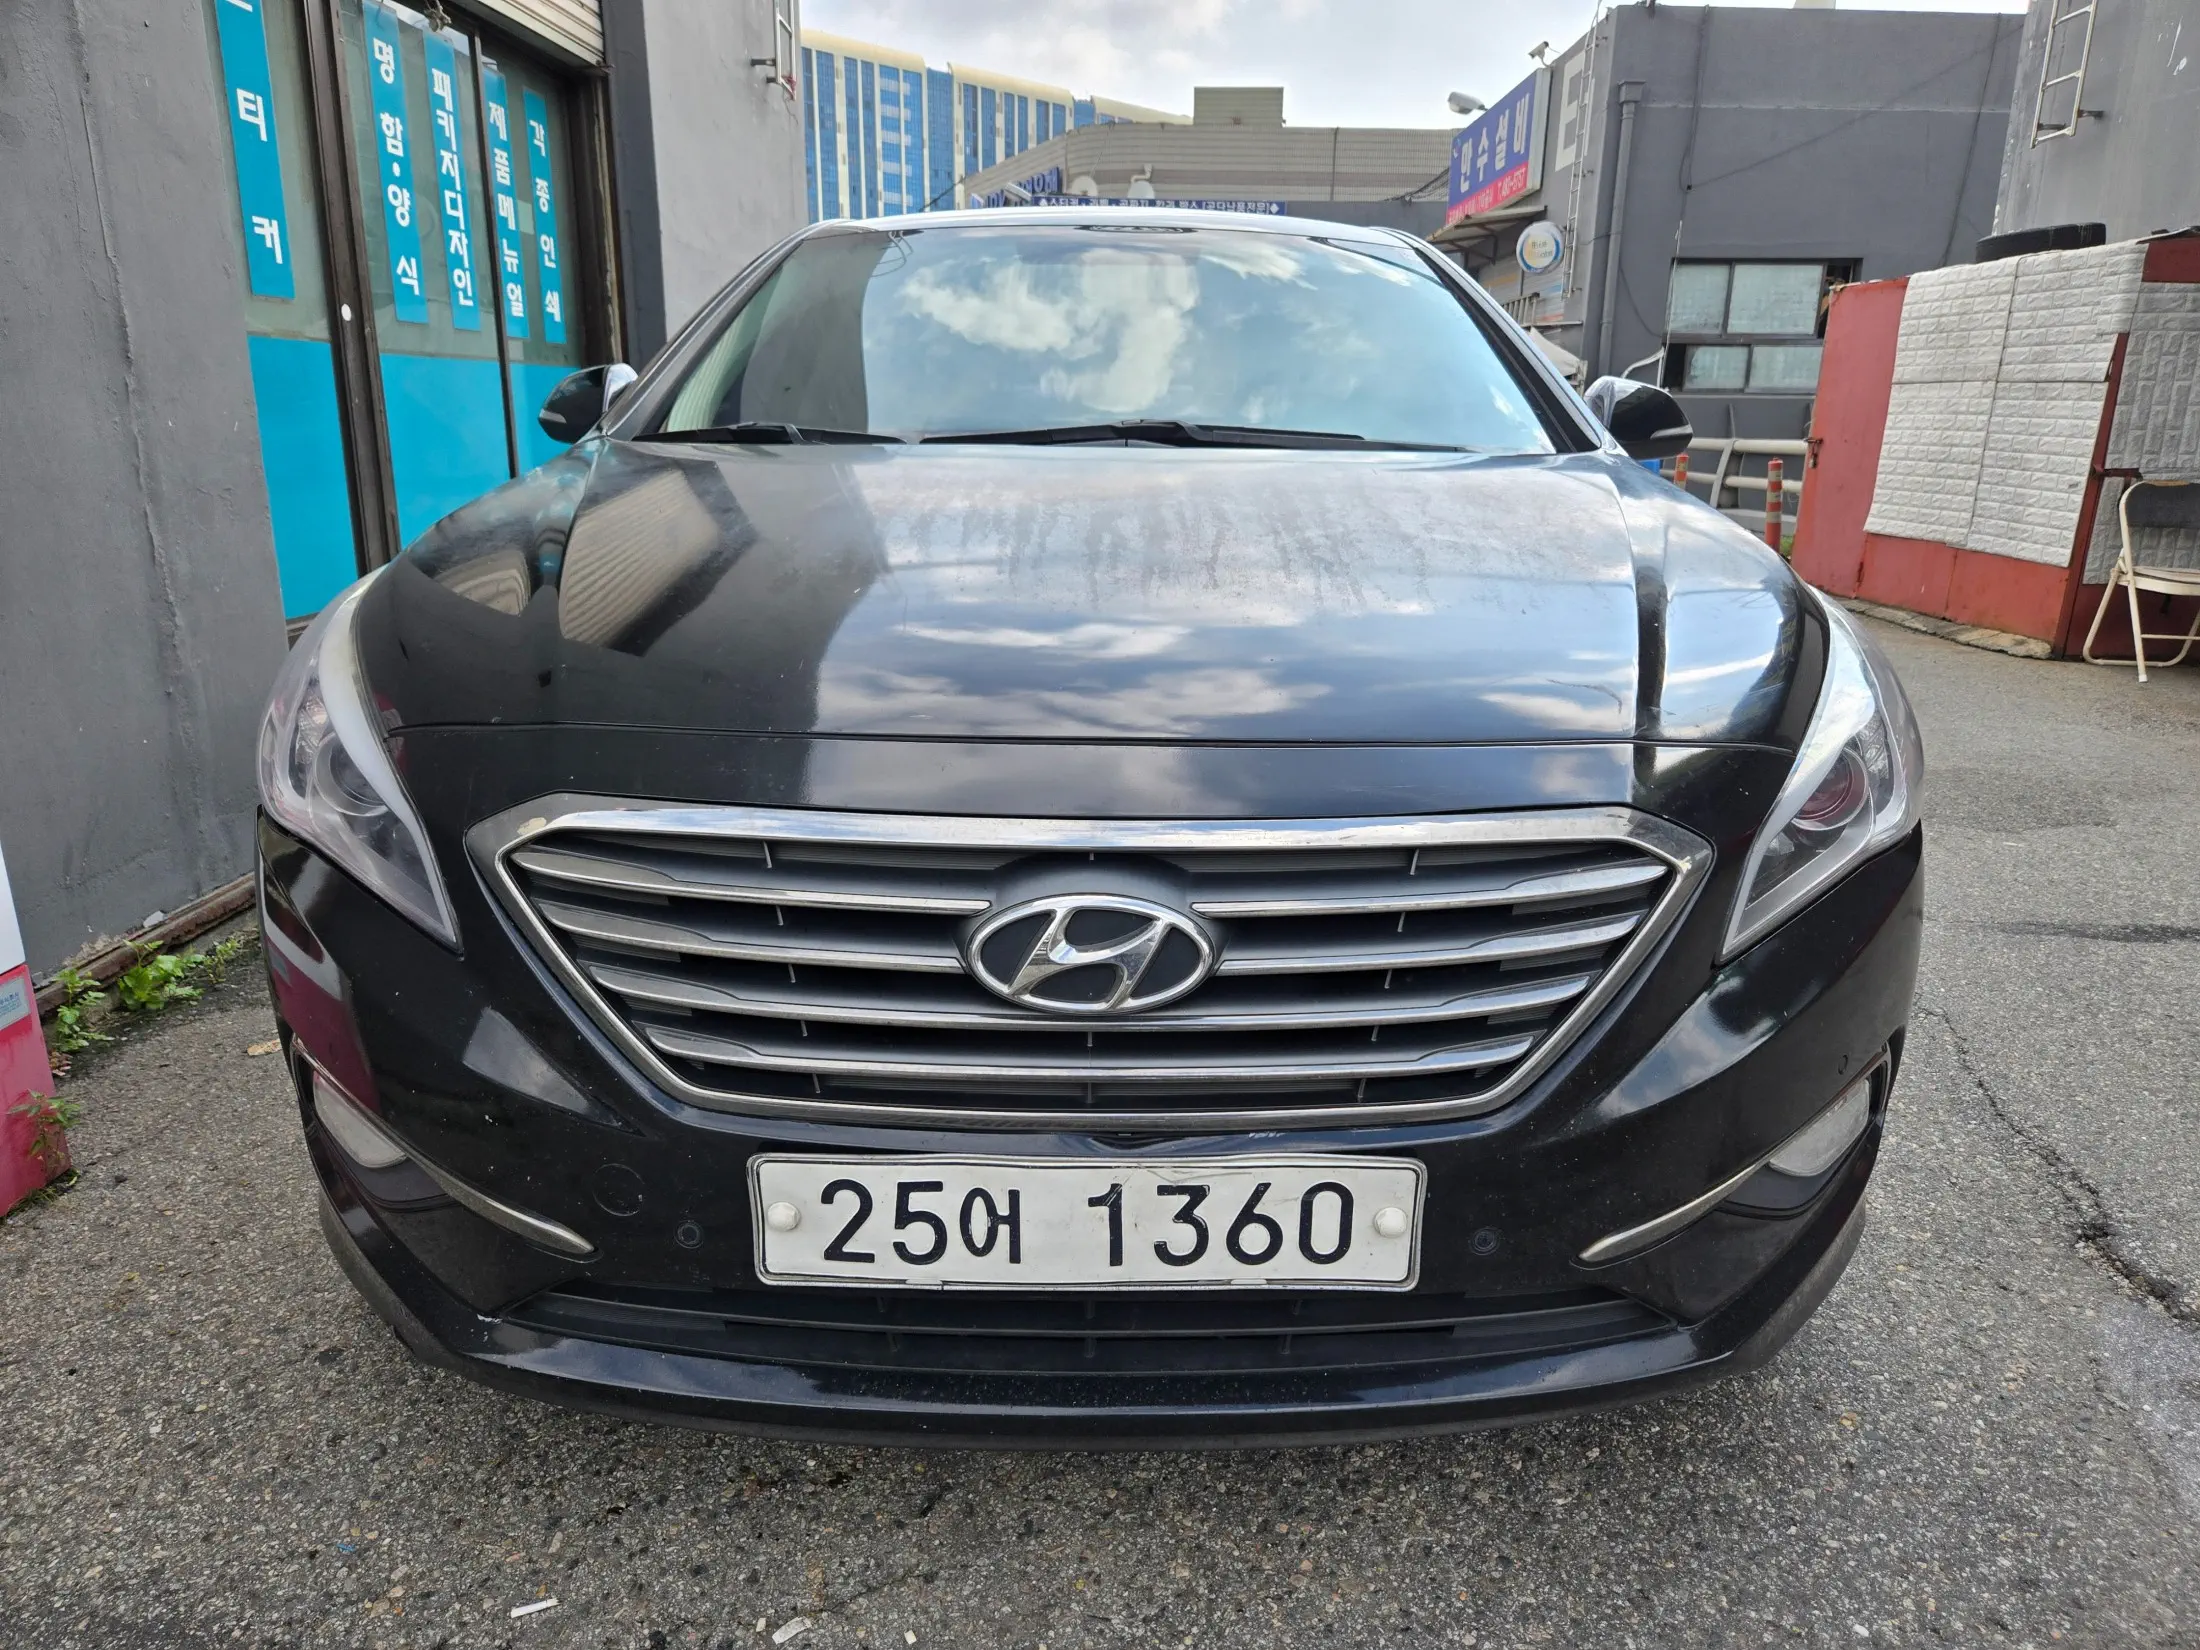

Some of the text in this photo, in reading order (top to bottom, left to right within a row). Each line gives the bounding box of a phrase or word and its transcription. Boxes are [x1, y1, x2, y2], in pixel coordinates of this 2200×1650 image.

[226, 0, 283, 264] 티커
[820, 1178, 1354, 1267] 25어 1360
